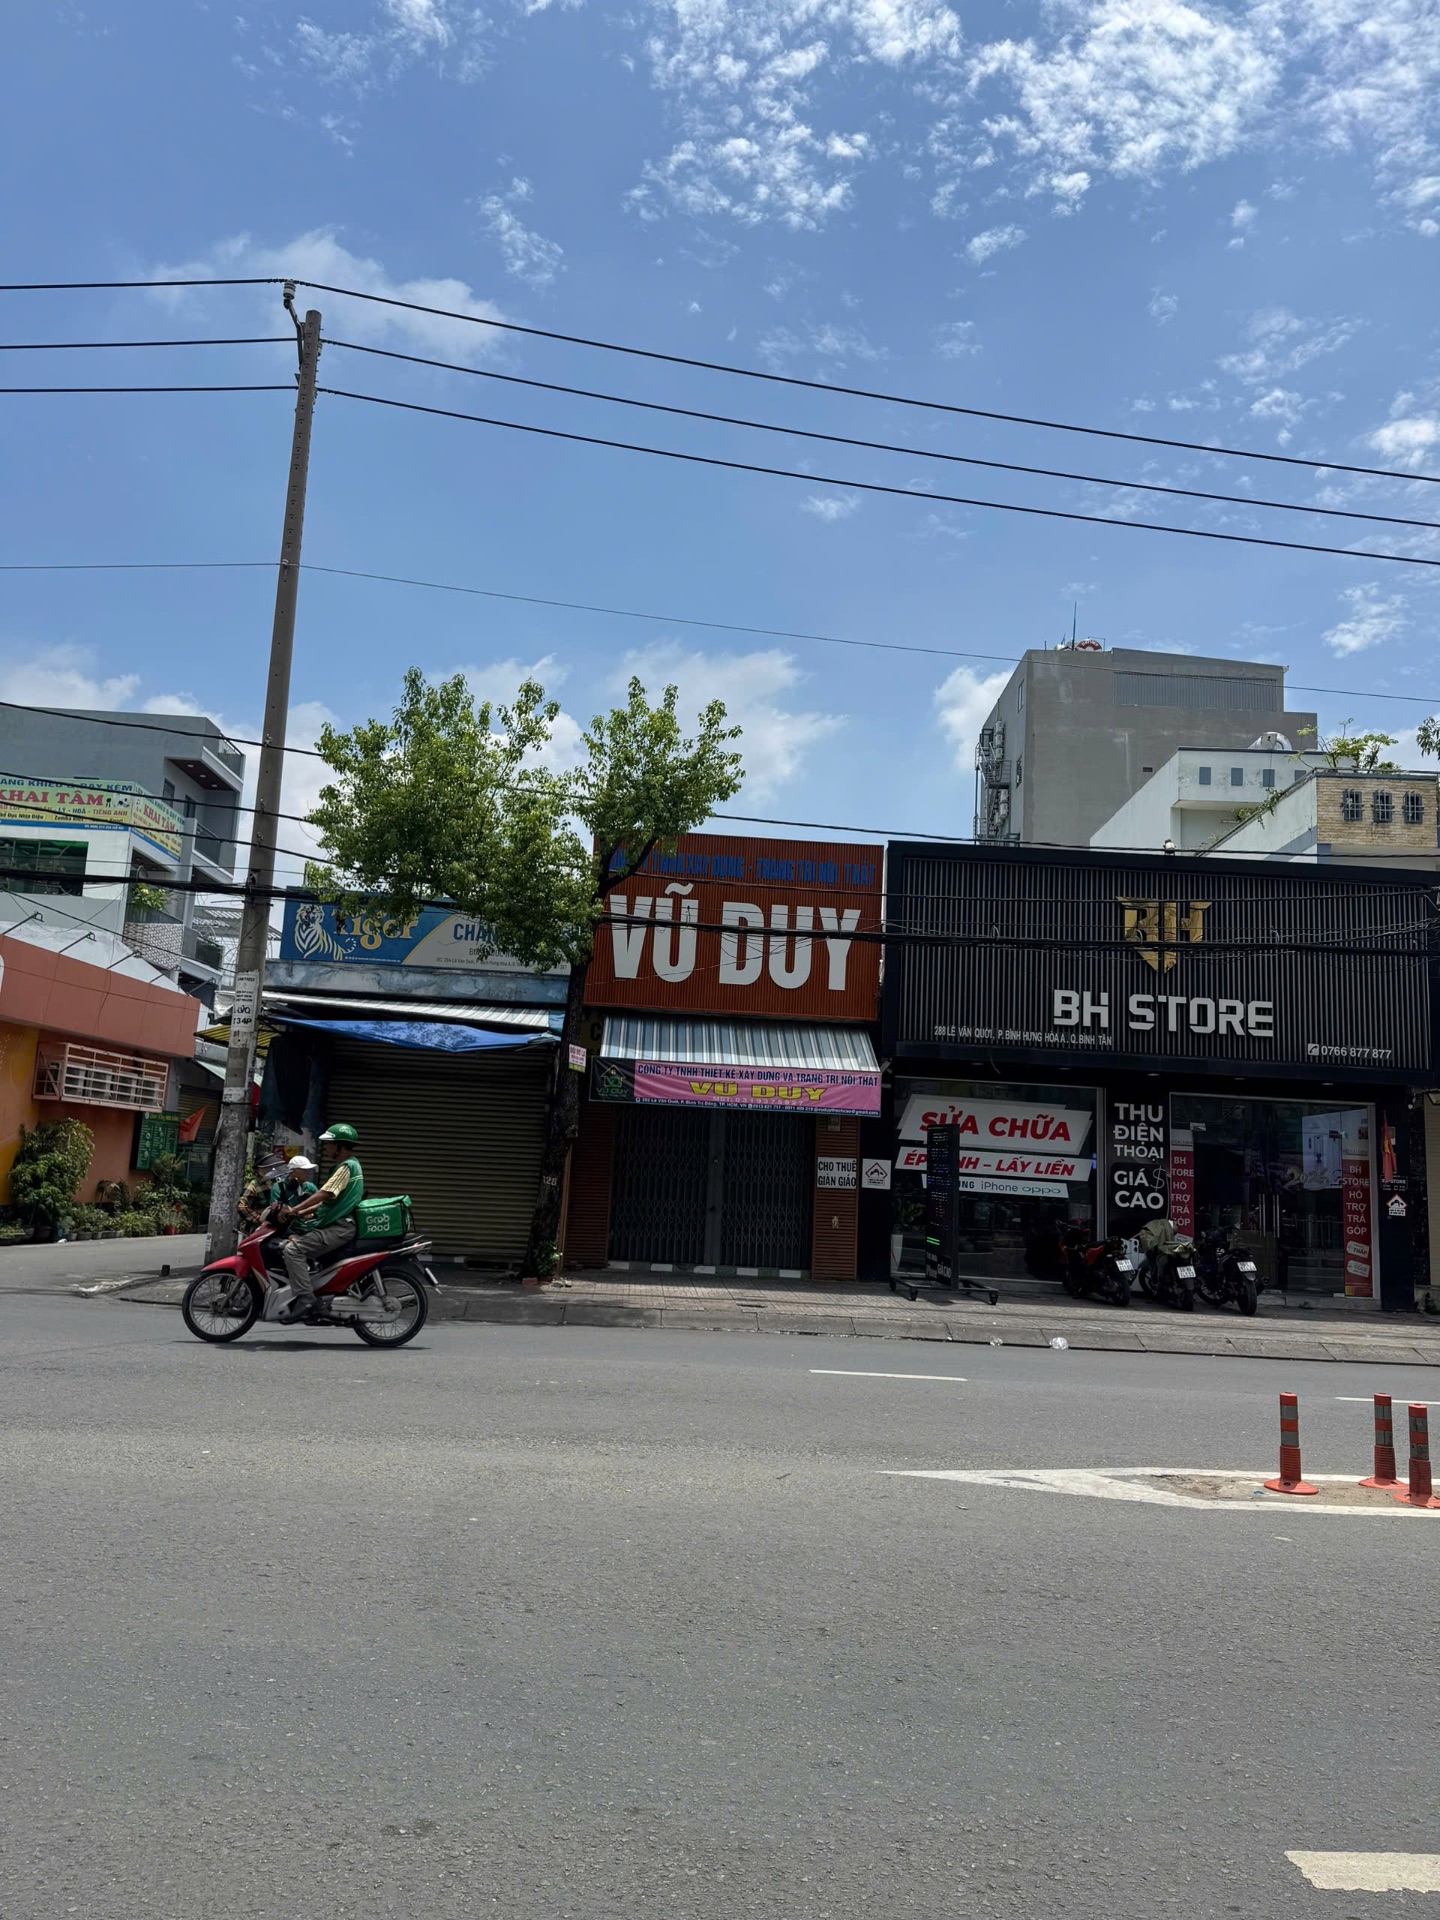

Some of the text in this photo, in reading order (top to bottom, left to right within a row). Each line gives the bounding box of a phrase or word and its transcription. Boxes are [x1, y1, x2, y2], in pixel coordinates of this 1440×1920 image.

[55, 790, 104, 806] TÂM
[609, 882, 862, 991] VŨ DUY
[1053, 989, 1274, 1037] BH STORE
[958, 1027, 972, 1037] VĂN
[1098, 1034, 1112, 1046] TÂN
[1320, 1045, 1392, 1059] 0766 877 877
[663, 1066, 674, 1075] TY
[676, 1066, 698, 1077] TNHH
[701, 1067, 723, 1079] THIẾT
[796, 1073, 823, 1084] TRANG
[689, 1080, 827, 1102] VŨ DUY
[1113, 1102, 1164, 1123] THU
[919, 1105, 1071, 1142] SỬA CHỮA
[1112, 1123, 1164, 1146] ĐIỆN
[1113, 1144, 1164, 1162] THOẠI
[1173, 1156, 1187, 1165] BH
[818, 1161, 834, 1172] CHO
[995, 1155, 1032, 1173] LẤY
[1033, 1158, 1076, 1176] LIỀN
[1170, 1168, 1195, 1178] TORE
[1349, 1165, 1362, 1174] BH
[838, 1174, 857, 1187] GIÁO
[1113, 1168, 1149, 1187] GIÁ
[1341, 1177, 1370, 1187] STORE
[980, 1181, 1019, 1192] iPhone
[1114, 1191, 1164, 1210] CAO
[365, 1213, 391, 1224] Grab
[366, 1223, 391, 1233] Food
[1346, 1224, 1367, 1236] GÓP
